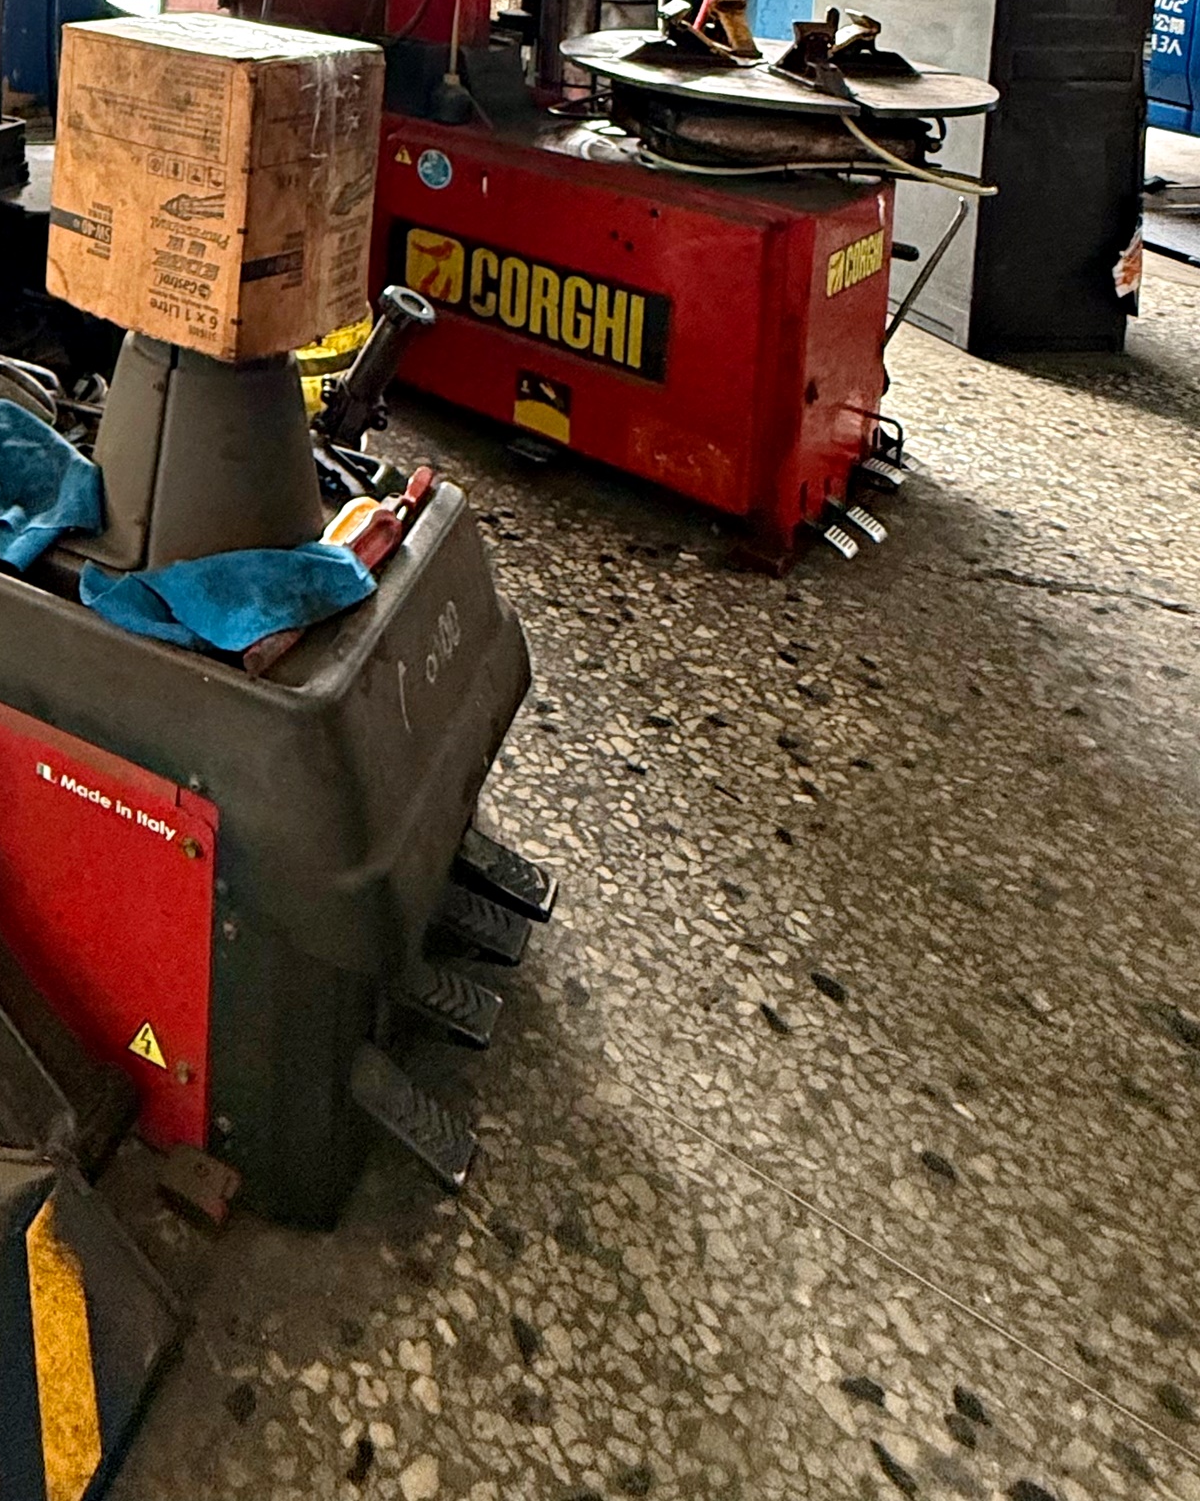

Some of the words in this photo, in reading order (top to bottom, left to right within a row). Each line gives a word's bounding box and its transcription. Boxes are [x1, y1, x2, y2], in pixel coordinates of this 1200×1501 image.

[844, 229, 885, 289] CORGHI
[158, 273, 198, 295] Castrol
[149, 297, 180, 319] Litre
[185, 308, 192, 322] 1
[469, 247, 645, 369] CORGHI
[209, 315, 218, 331] 6
[60, 774, 112, 809] Made
[115, 799, 132, 820] in
[136, 810, 177, 842] Italy
